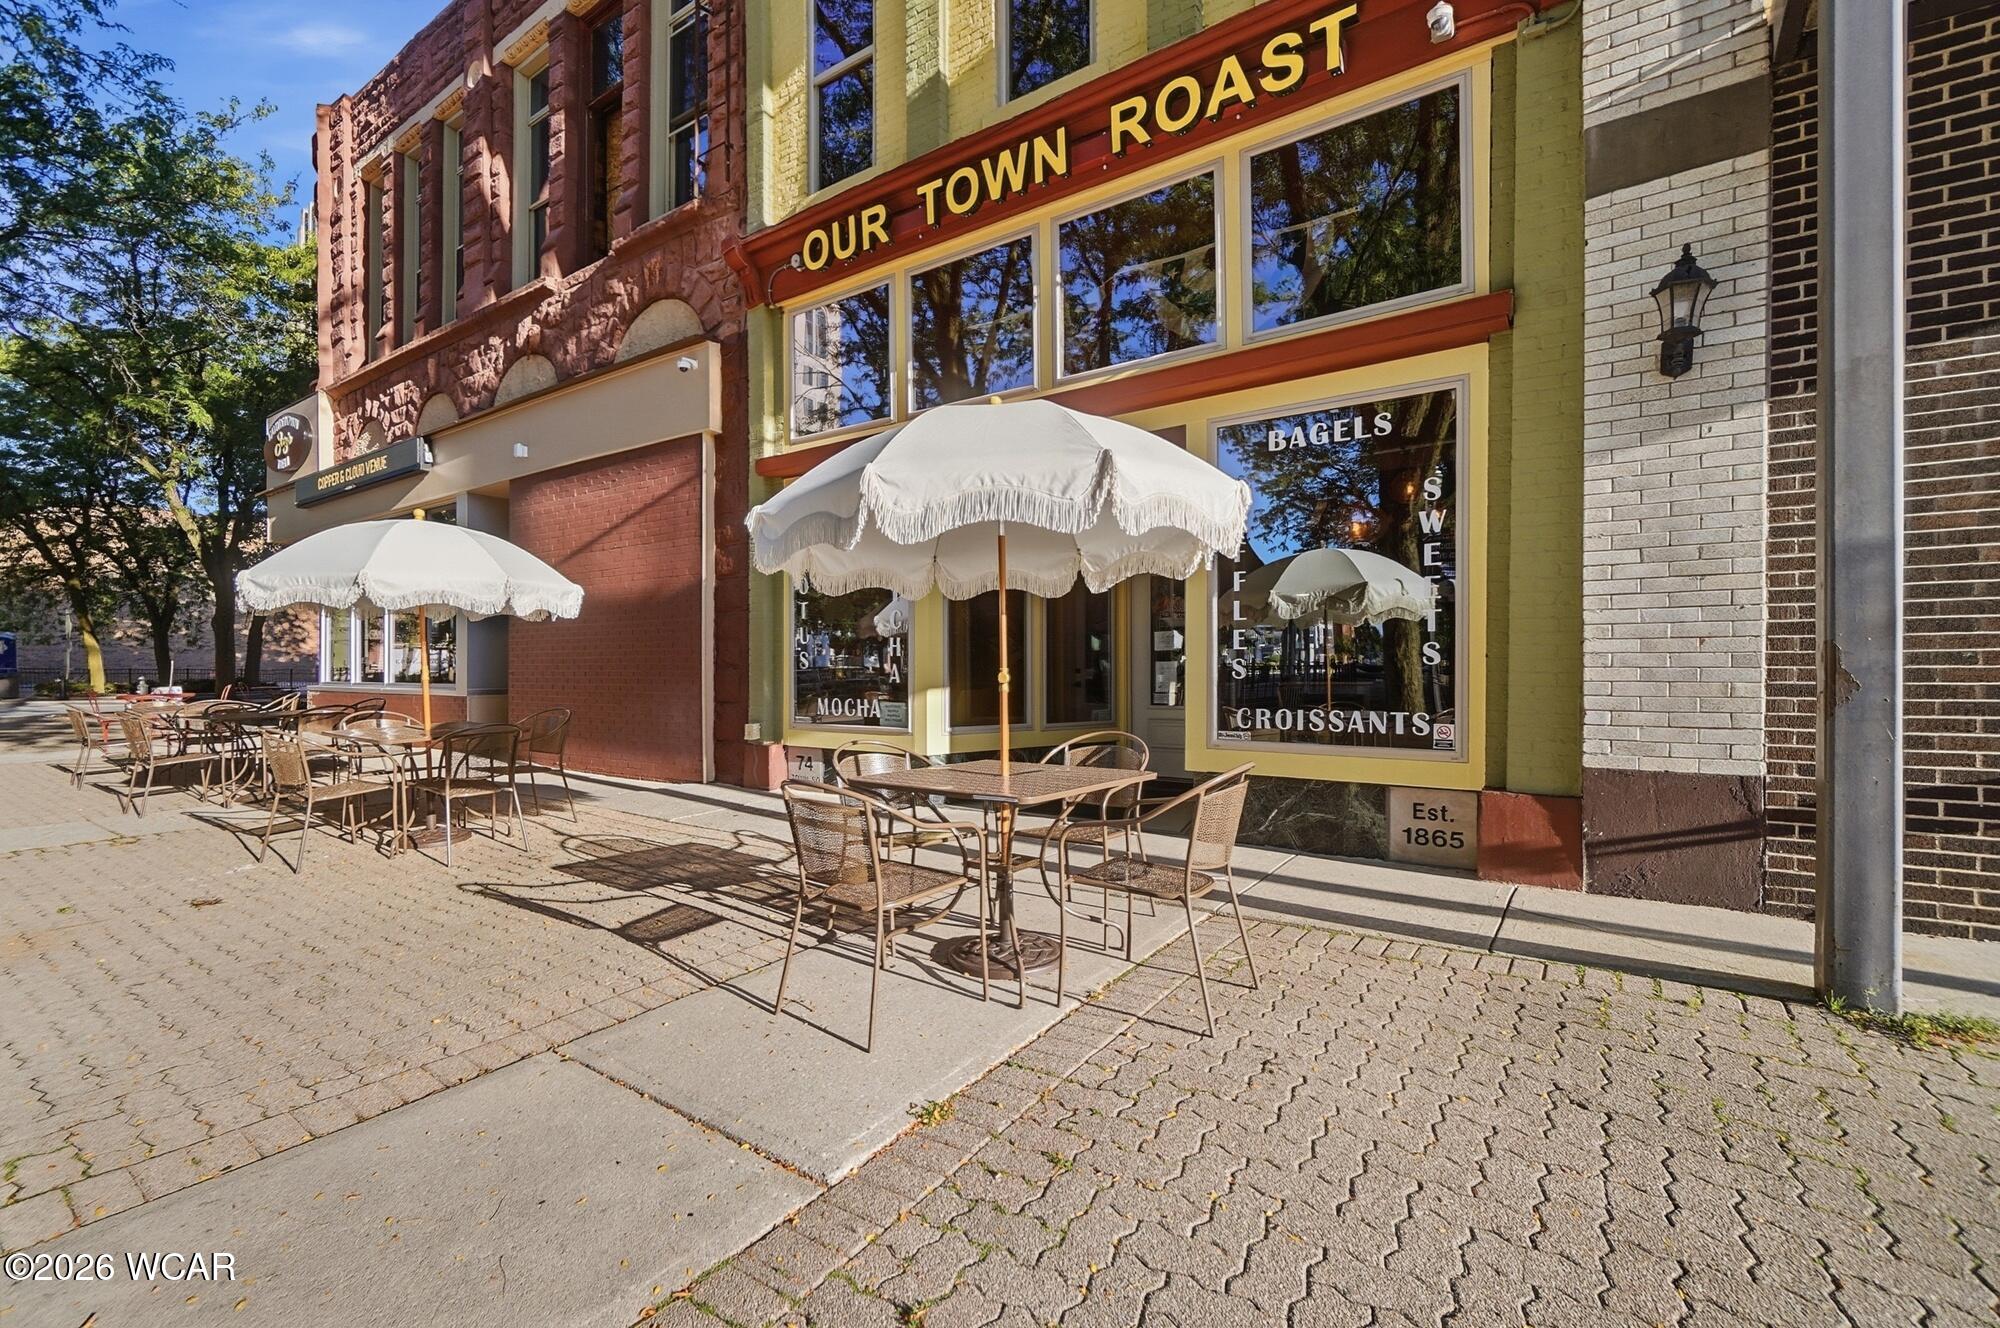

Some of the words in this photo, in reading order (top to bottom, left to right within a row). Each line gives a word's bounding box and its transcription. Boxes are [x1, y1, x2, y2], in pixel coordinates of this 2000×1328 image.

[802, 203, 889, 272] OUR
[916, 126, 1069, 227] TOWN
[1110, 3, 1359, 154] ROAST
[1267, 411, 1393, 452] BAGELS
[317, 471, 340, 490] COPPER
[345, 462, 365, 481] CLOUD
[365, 455, 388, 475] VENUE
[1418, 476, 1447, 665] SWEETS
[817, 697, 881, 718] MOCHA
[1236, 707, 1431, 736] CROISSANTS
[796, 754, 813, 771] 74
[1412, 802, 1455, 823] Est.
[1402, 827, 1465, 849] 1865
